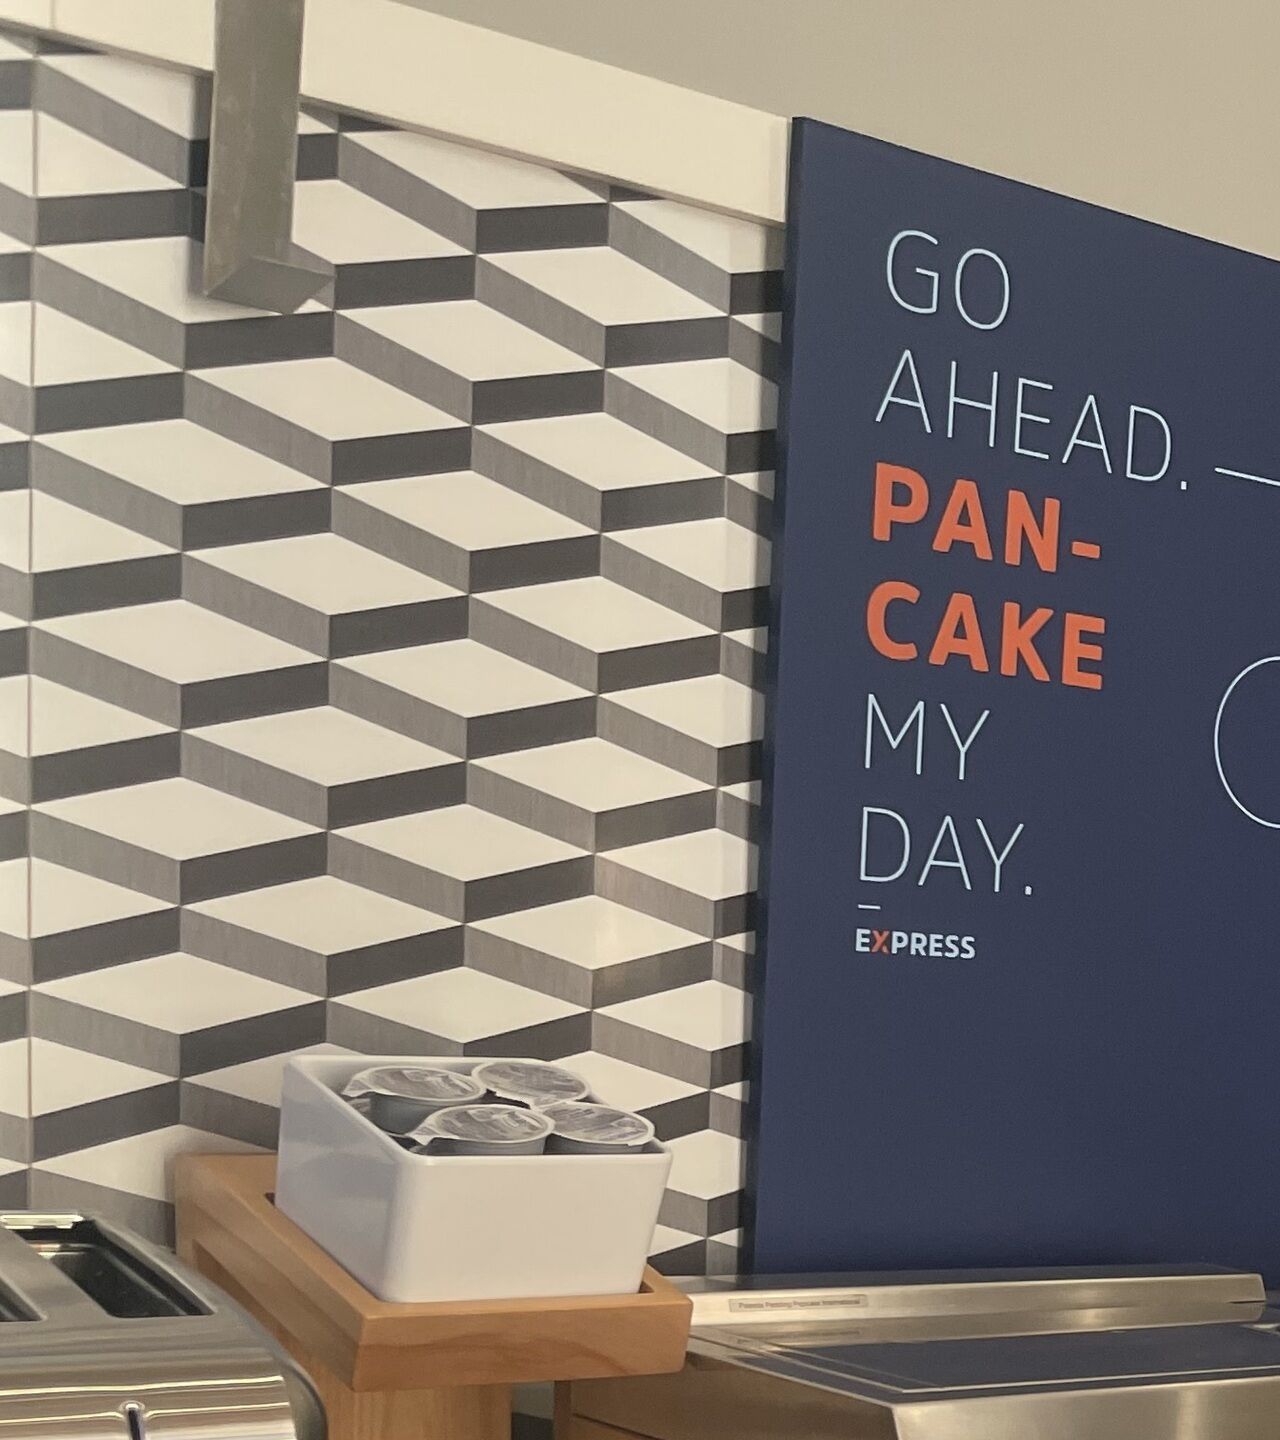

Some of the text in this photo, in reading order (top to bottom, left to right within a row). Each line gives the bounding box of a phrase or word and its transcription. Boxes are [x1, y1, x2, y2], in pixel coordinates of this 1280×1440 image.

[886, 230, 1010, 330] GO
[875, 349, 1189, 490] AHEAD.
[873, 461, 1102, 573] PAN-
[865, 580, 1106, 689] CAKE
[864, 693, 991, 781] MY
[857, 805, 1034, 896] DAY.
[855, 928, 976, 960] EXPRESS
